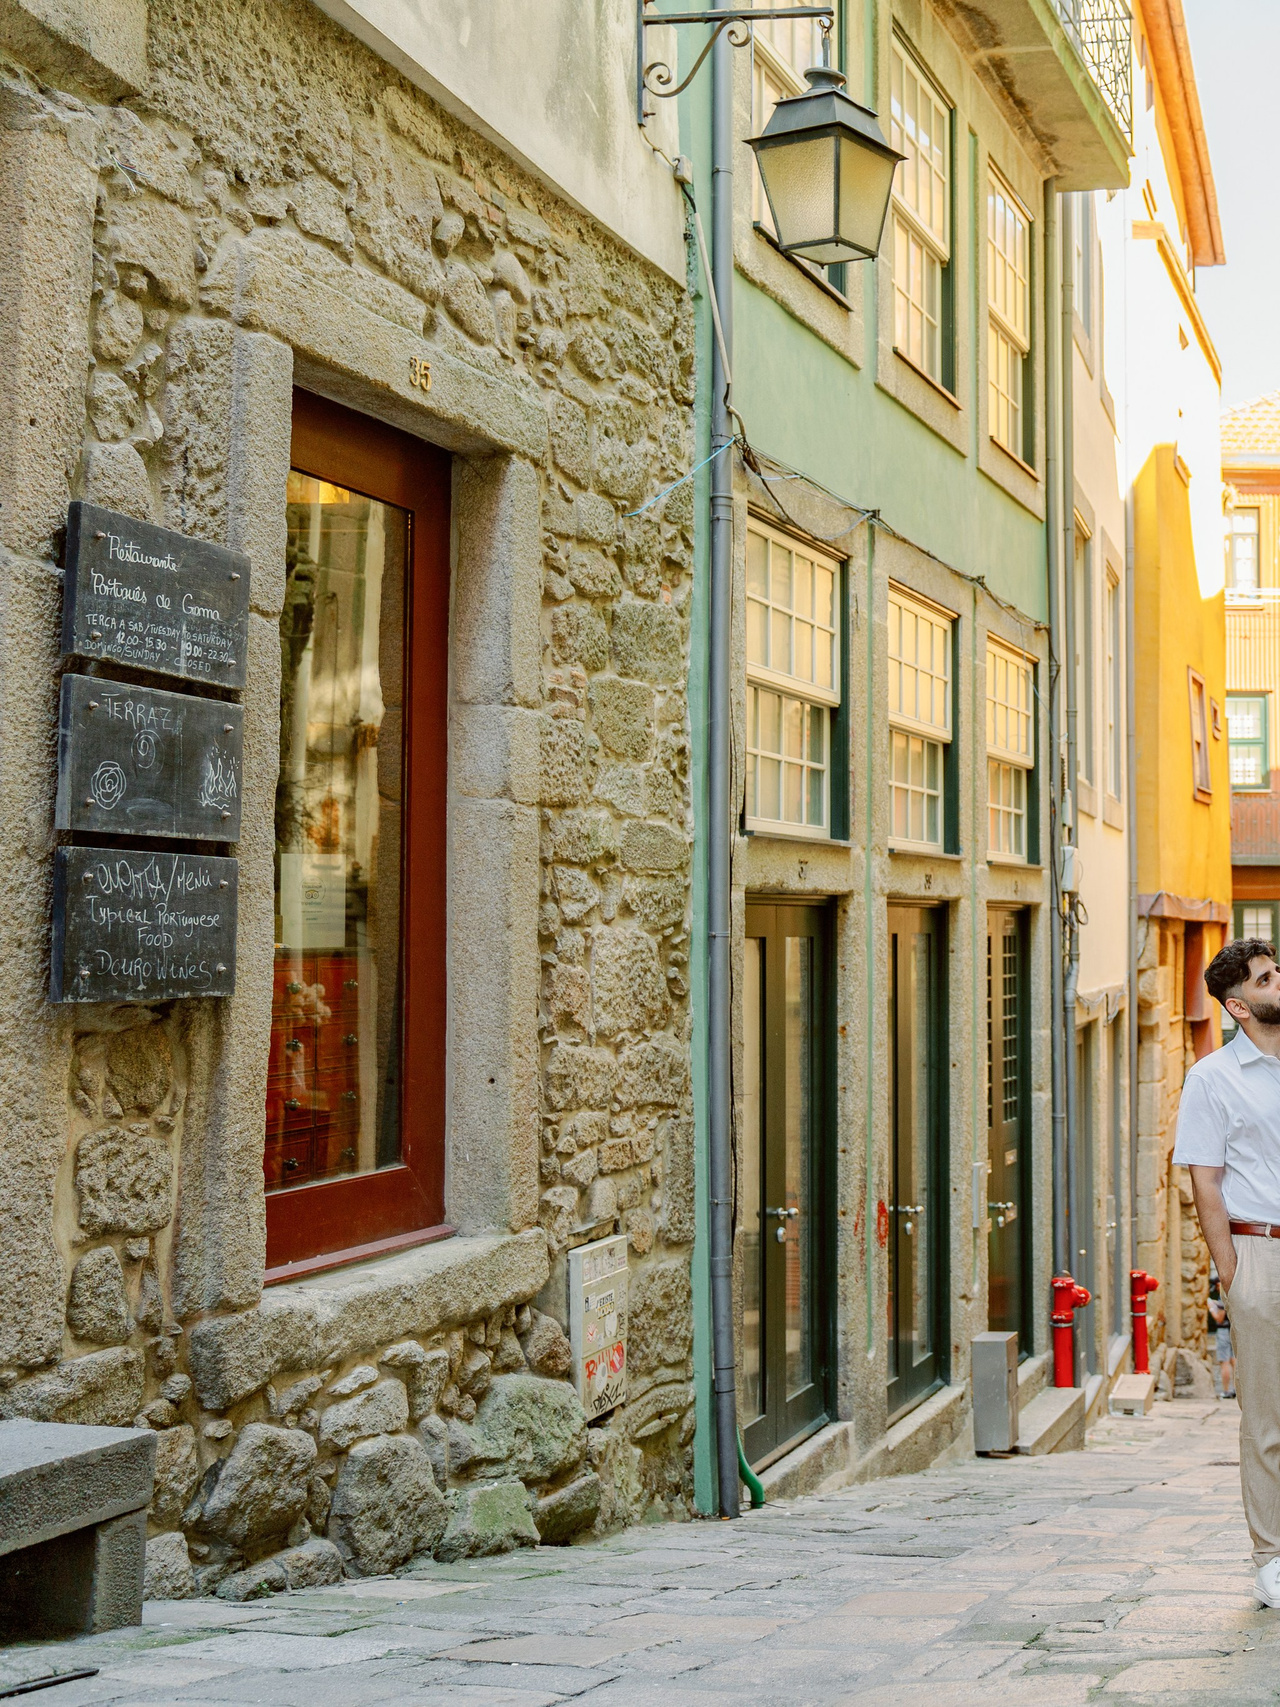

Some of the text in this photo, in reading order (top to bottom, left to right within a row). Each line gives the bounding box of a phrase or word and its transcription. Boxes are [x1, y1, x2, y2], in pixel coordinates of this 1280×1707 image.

[410, 356, 432, 391] 35
[107, 532, 178, 572] Restaurante
[90, 567, 147, 604] Português
[155, 594, 172, 610] de
[119, 618, 126, 630] A
[192, 632, 233, 650] SATURDAY
